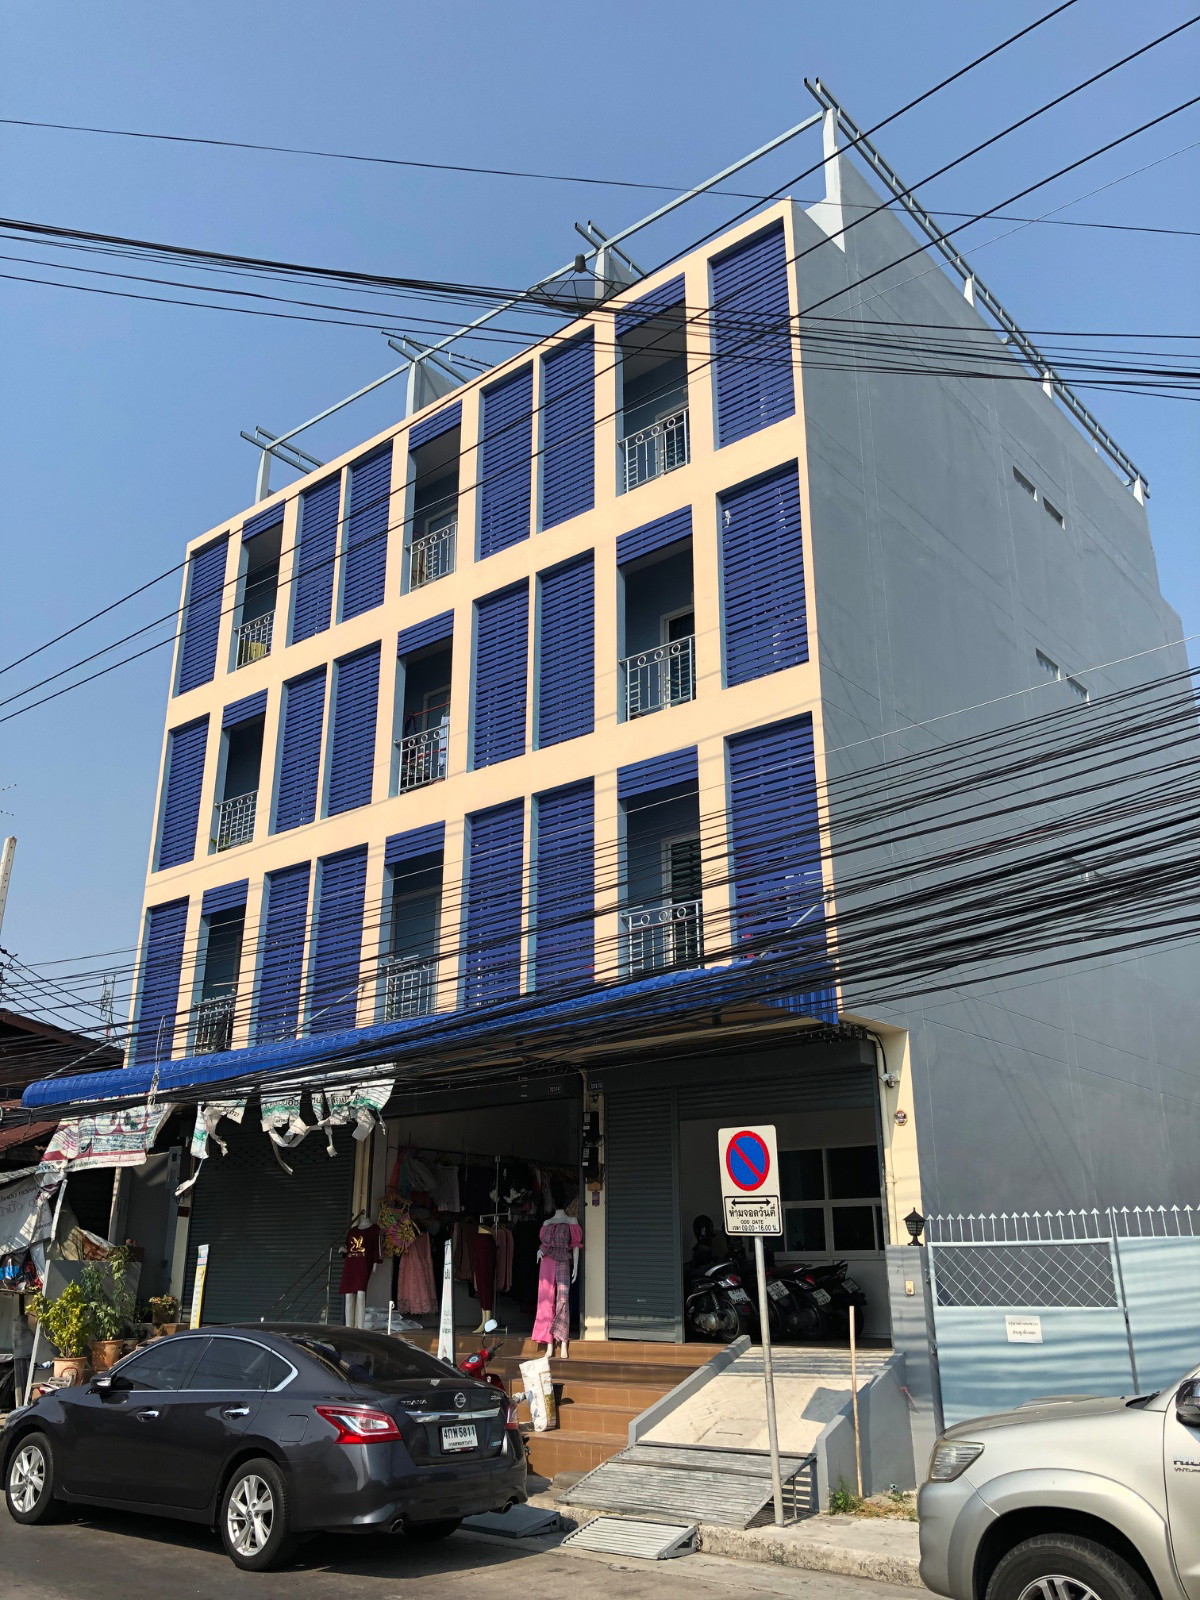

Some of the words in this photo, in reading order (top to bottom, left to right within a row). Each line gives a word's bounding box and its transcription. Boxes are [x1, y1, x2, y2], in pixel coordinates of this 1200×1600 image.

[729, 1204, 776, 1218] ห้ามจอดวันคี่
